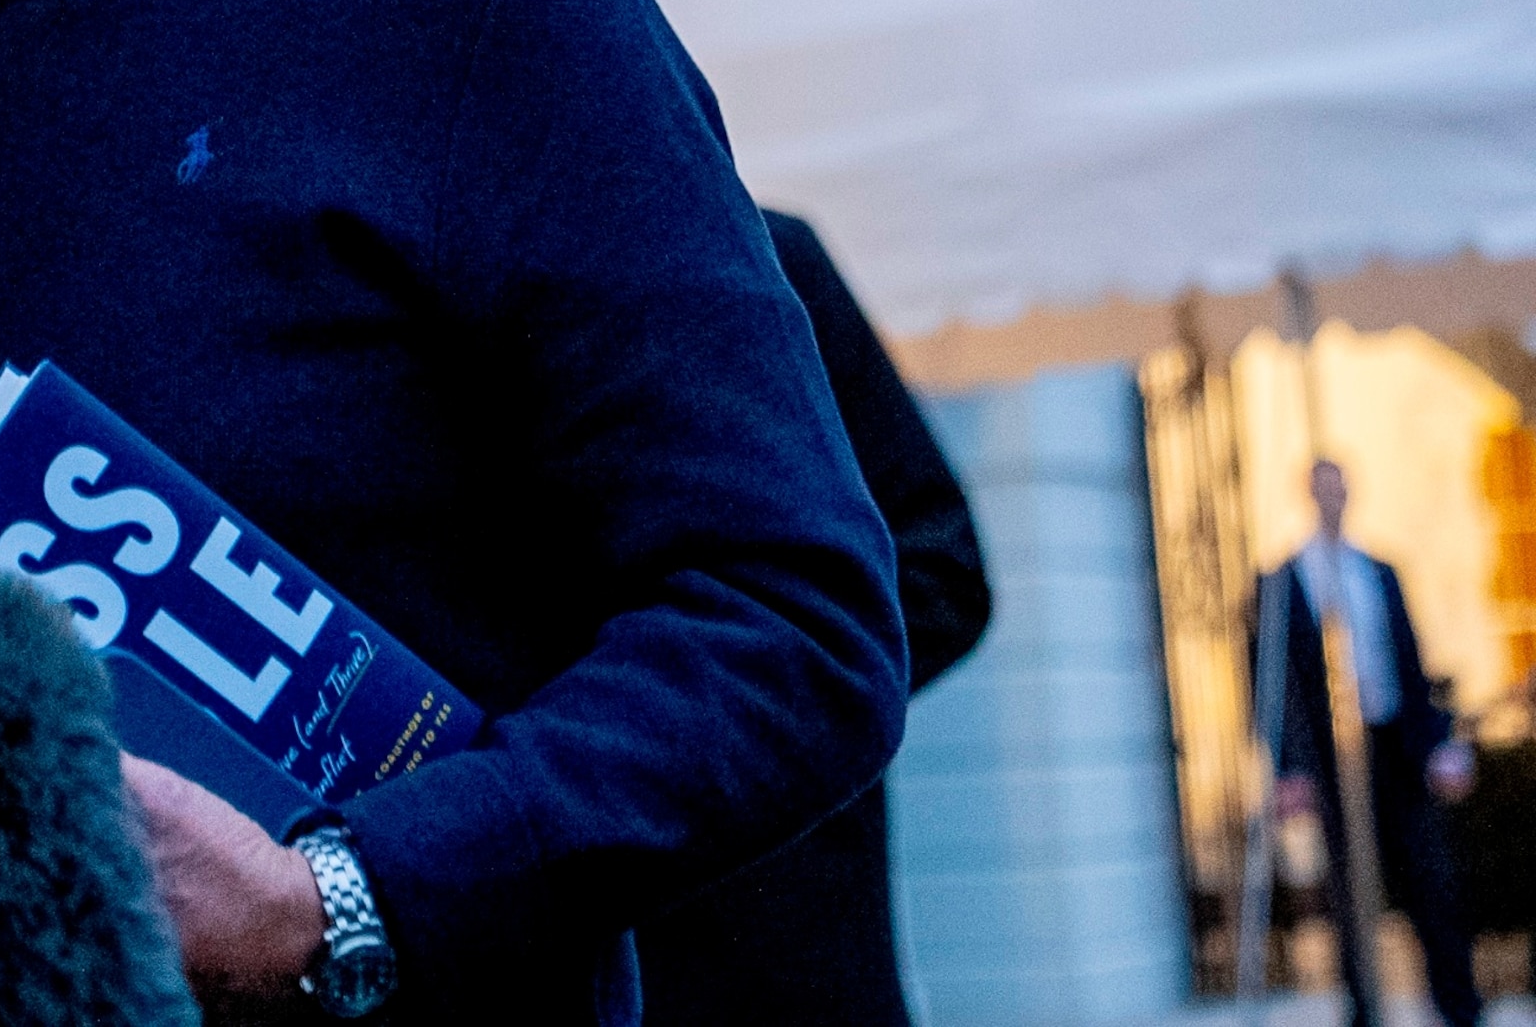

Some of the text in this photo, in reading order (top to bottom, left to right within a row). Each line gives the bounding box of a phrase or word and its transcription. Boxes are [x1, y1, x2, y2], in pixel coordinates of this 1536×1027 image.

[142, 516, 334, 723] LE
[311, 733, 356, 800] onflict
[375, 691, 434, 781] COAUTHOR OF
